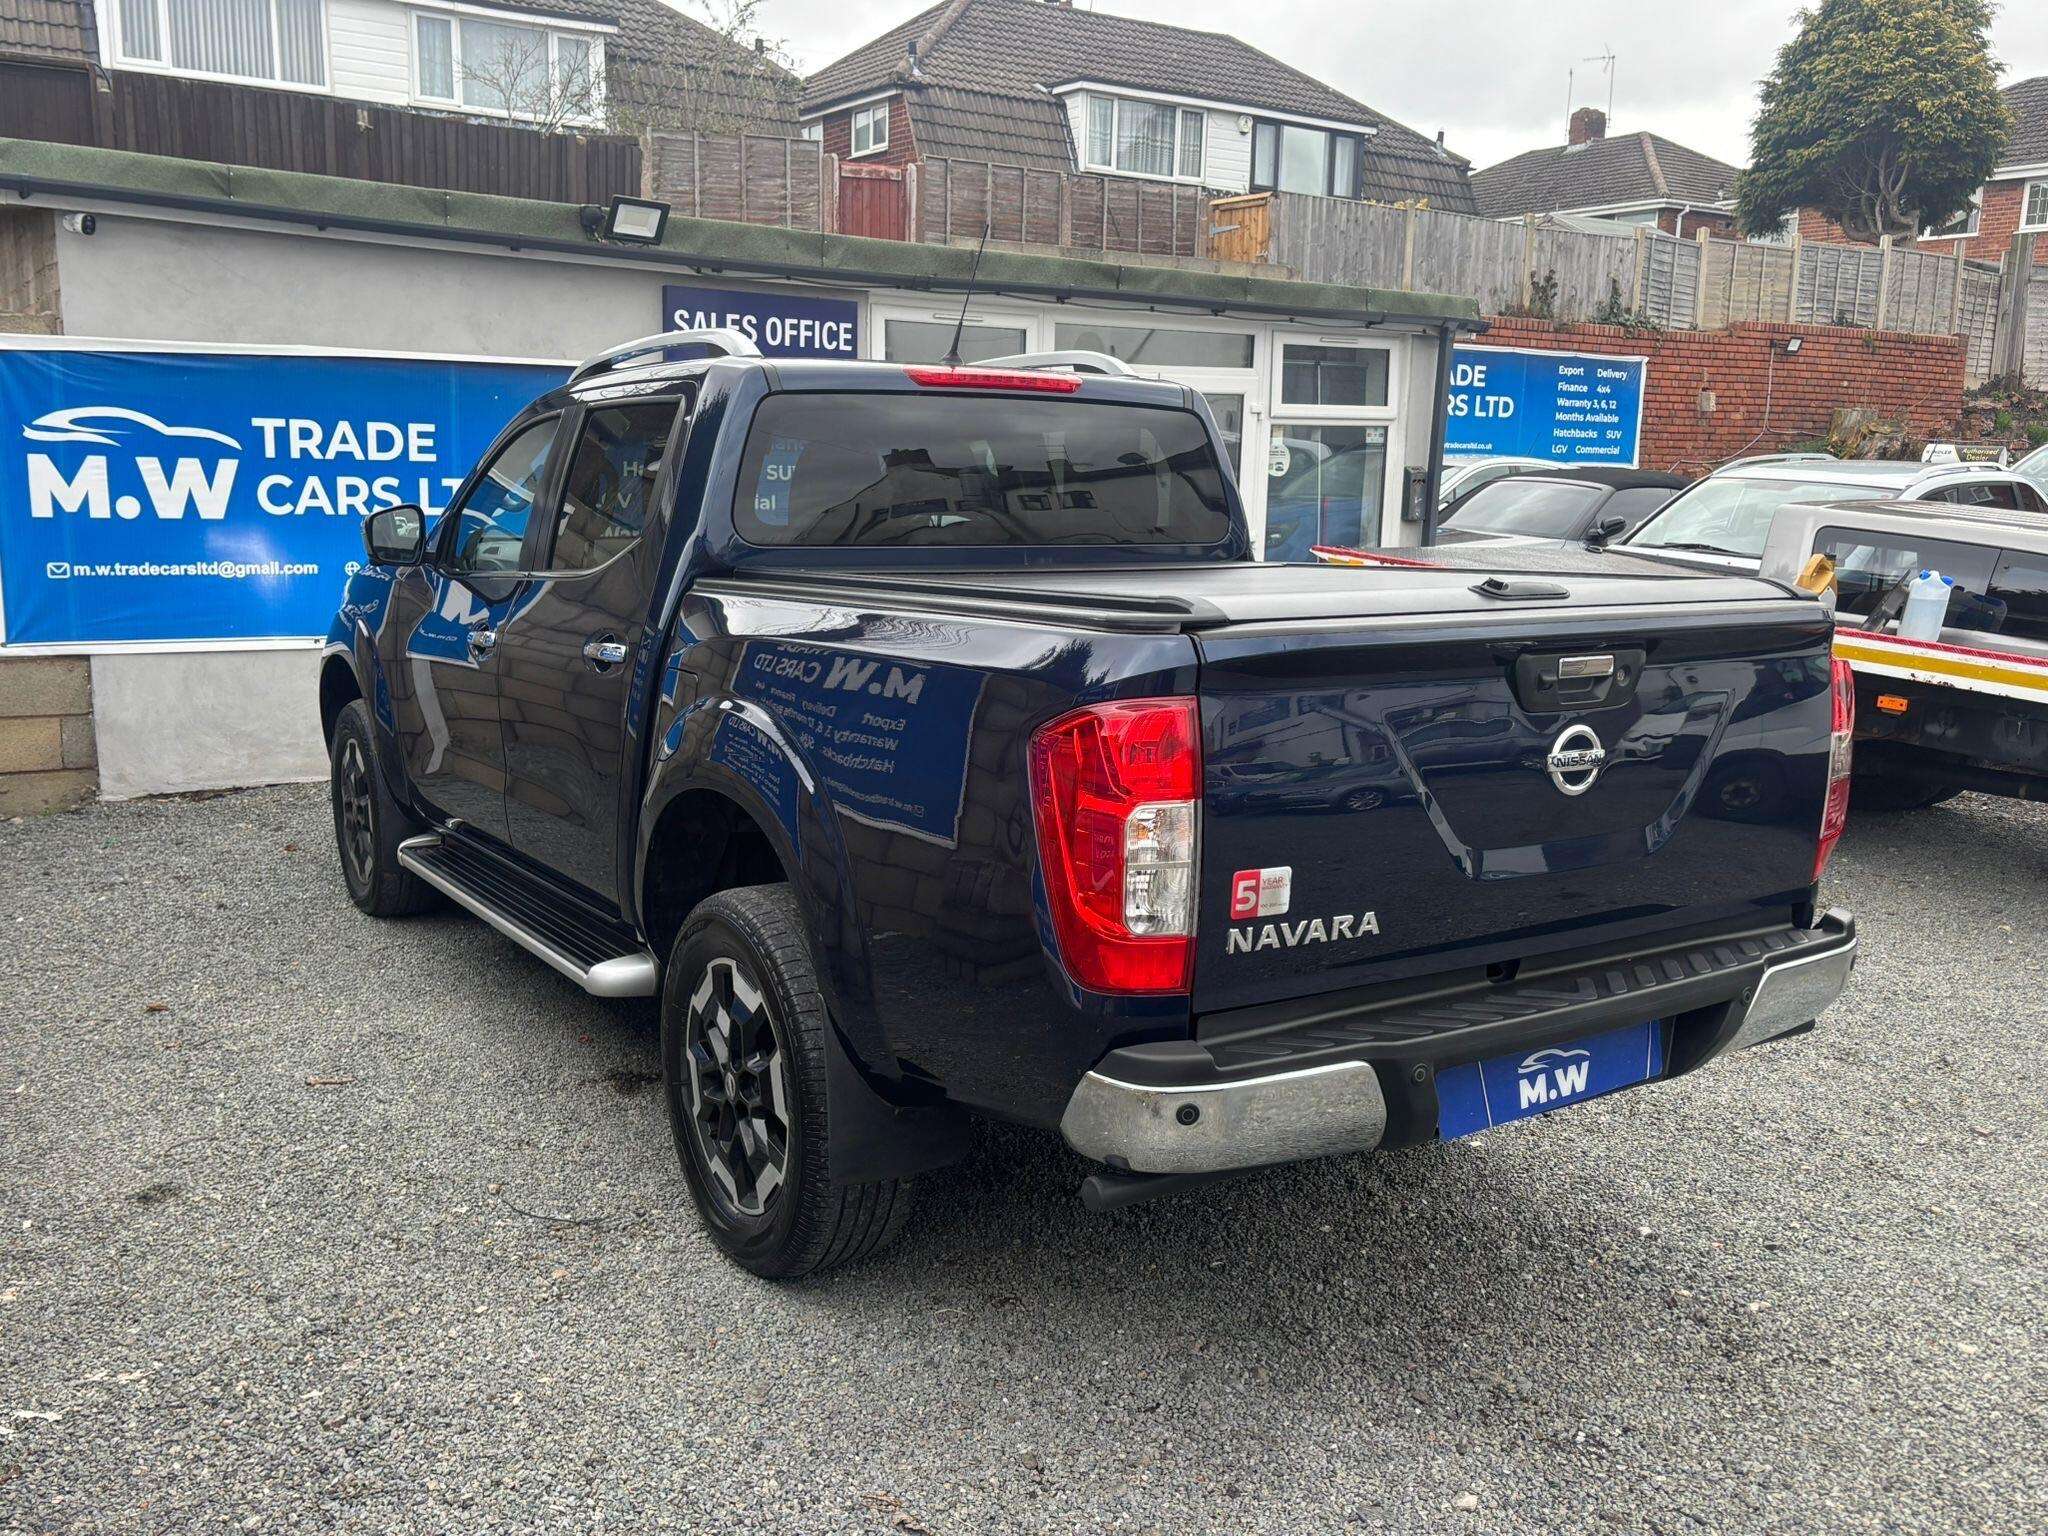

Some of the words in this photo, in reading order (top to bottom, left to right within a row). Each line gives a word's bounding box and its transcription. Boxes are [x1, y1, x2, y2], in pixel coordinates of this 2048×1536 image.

[765, 316, 853, 351] OFFICE
[1558, 365, 1584, 376] Export
[1597, 368, 1628, 381] Delivery
[1557, 381, 1588, 393] Finance
[1596, 384, 1611, 394] 4x4
[1474, 394, 1515, 418] LTD
[1556, 397, 1592, 410] Warranty
[1592, 399, 1600, 410] 3,
[1600, 400, 1608, 410] 6,
[1608, 400, 1617, 409] 12
[1555, 411, 1585, 422] Months
[1585, 413, 1620, 423] Available
[251, 417, 437, 463] TRADE
[1553, 428, 1598, 439] Hatchbacks
[1606, 429, 1623, 439] SUV
[1552, 444, 1568, 454] LGV
[1575, 445, 1620, 455] Commercial
[1961, 447, 2000, 456] Authorised
[26, 453, 240, 519] M.W
[256, 474, 402, 516] CARS
[1556, 753, 1602, 768] NISSAN
[1235, 879, 1257, 913] 5
[1262, 876, 1283, 886] YEAR
[1226, 911, 1380, 955] NAVARA
[1519, 1060, 1590, 1110] M.W
